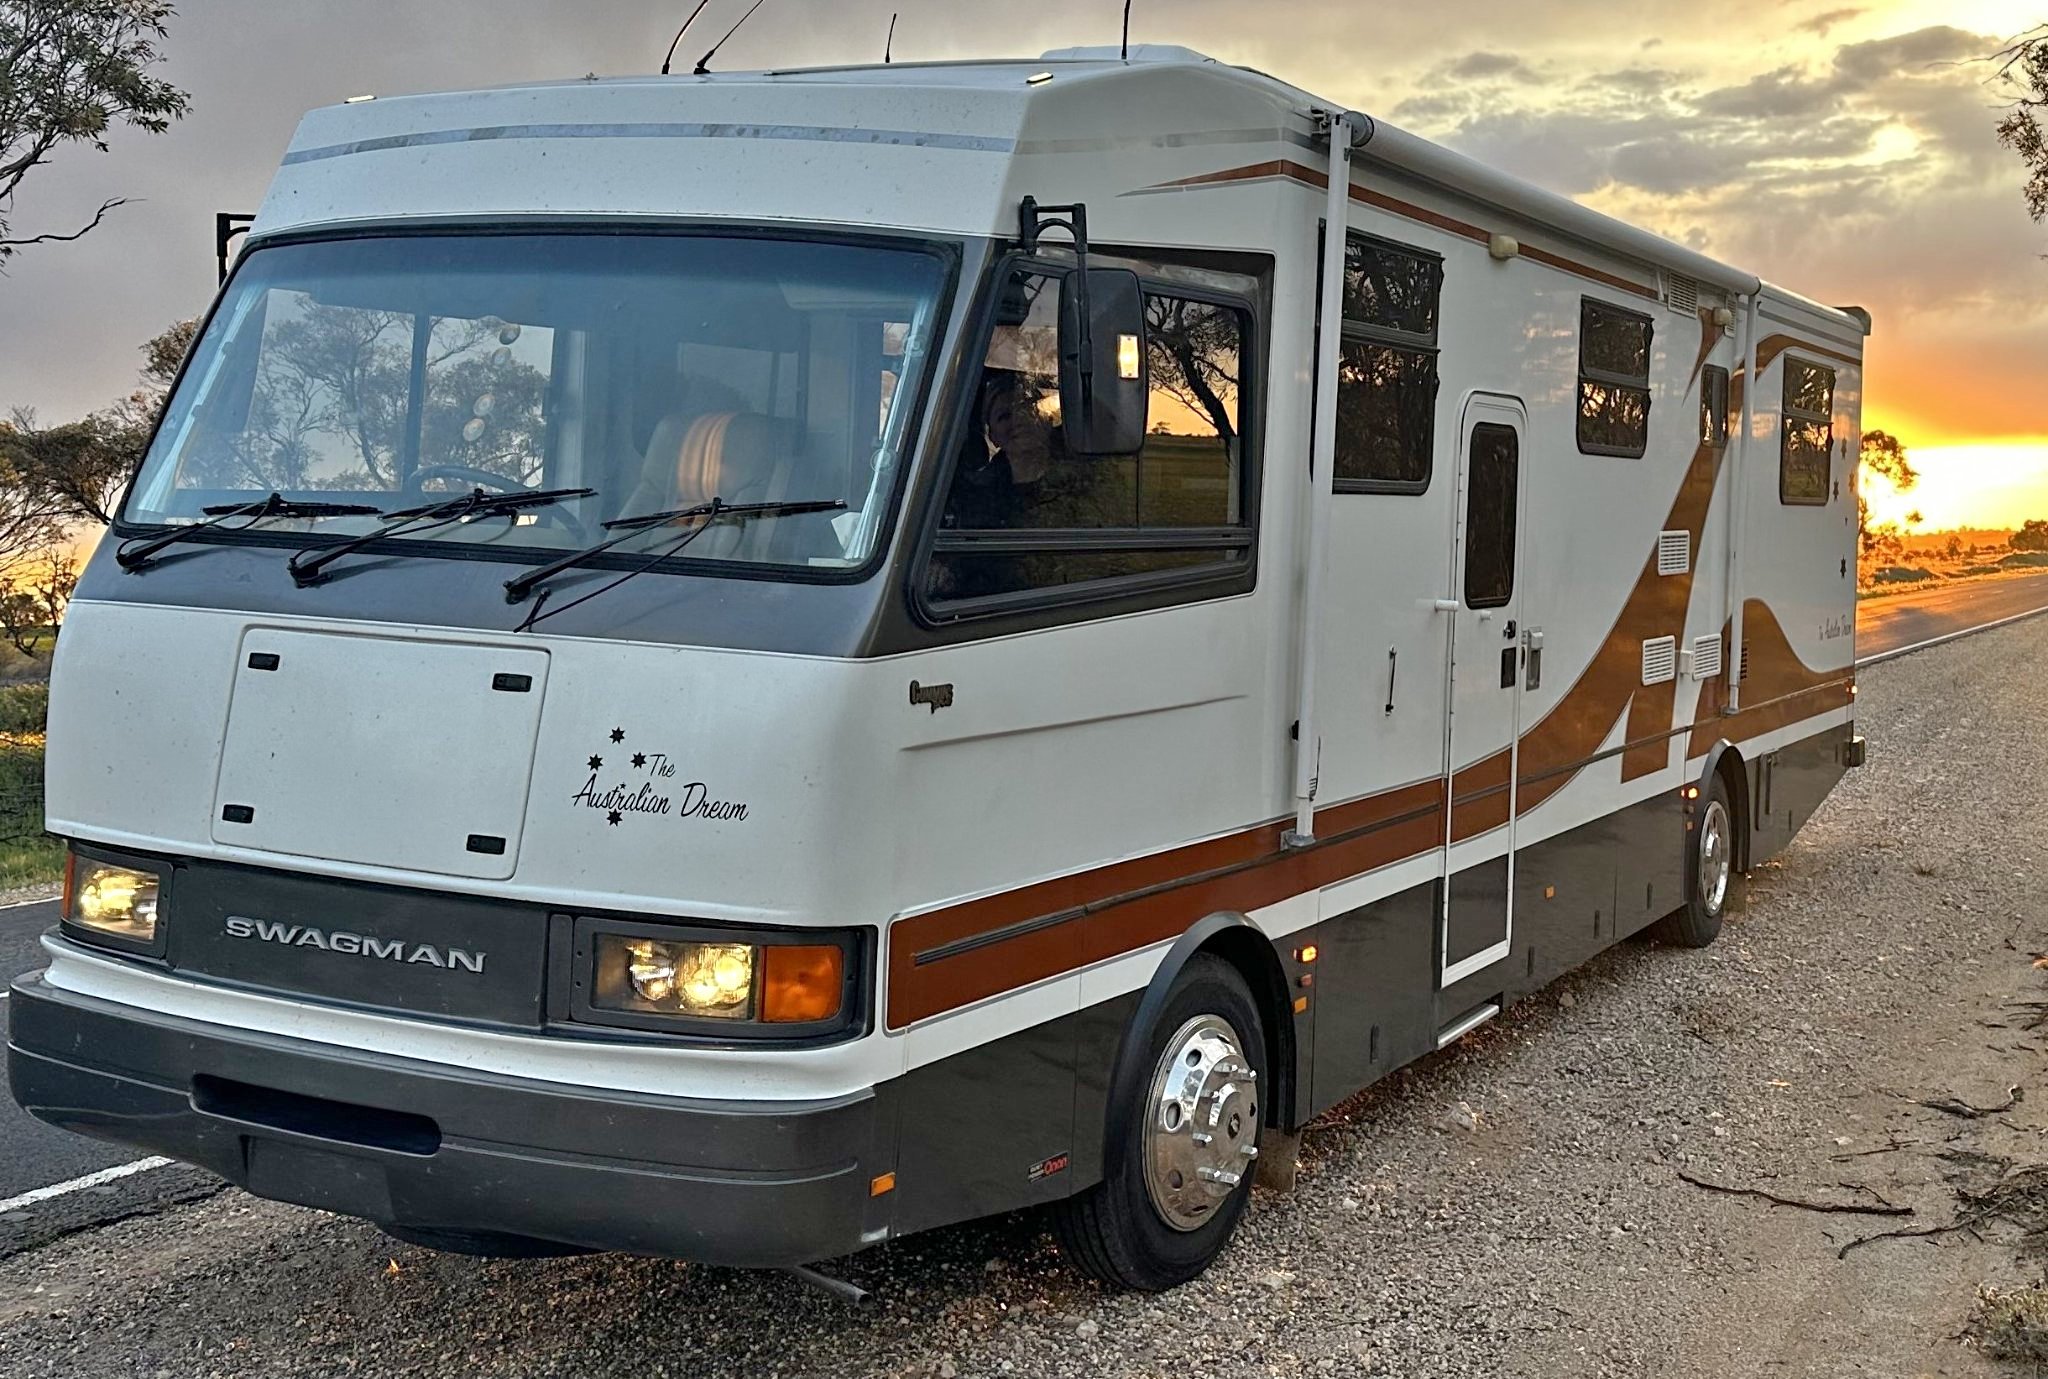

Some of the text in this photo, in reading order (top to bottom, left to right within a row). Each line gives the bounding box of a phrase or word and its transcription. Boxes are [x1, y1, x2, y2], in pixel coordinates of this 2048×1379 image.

[650, 754, 675, 777] The
[571, 773, 749, 821] Australian Dream
[225, 915, 487, 973] SWAGMAN
